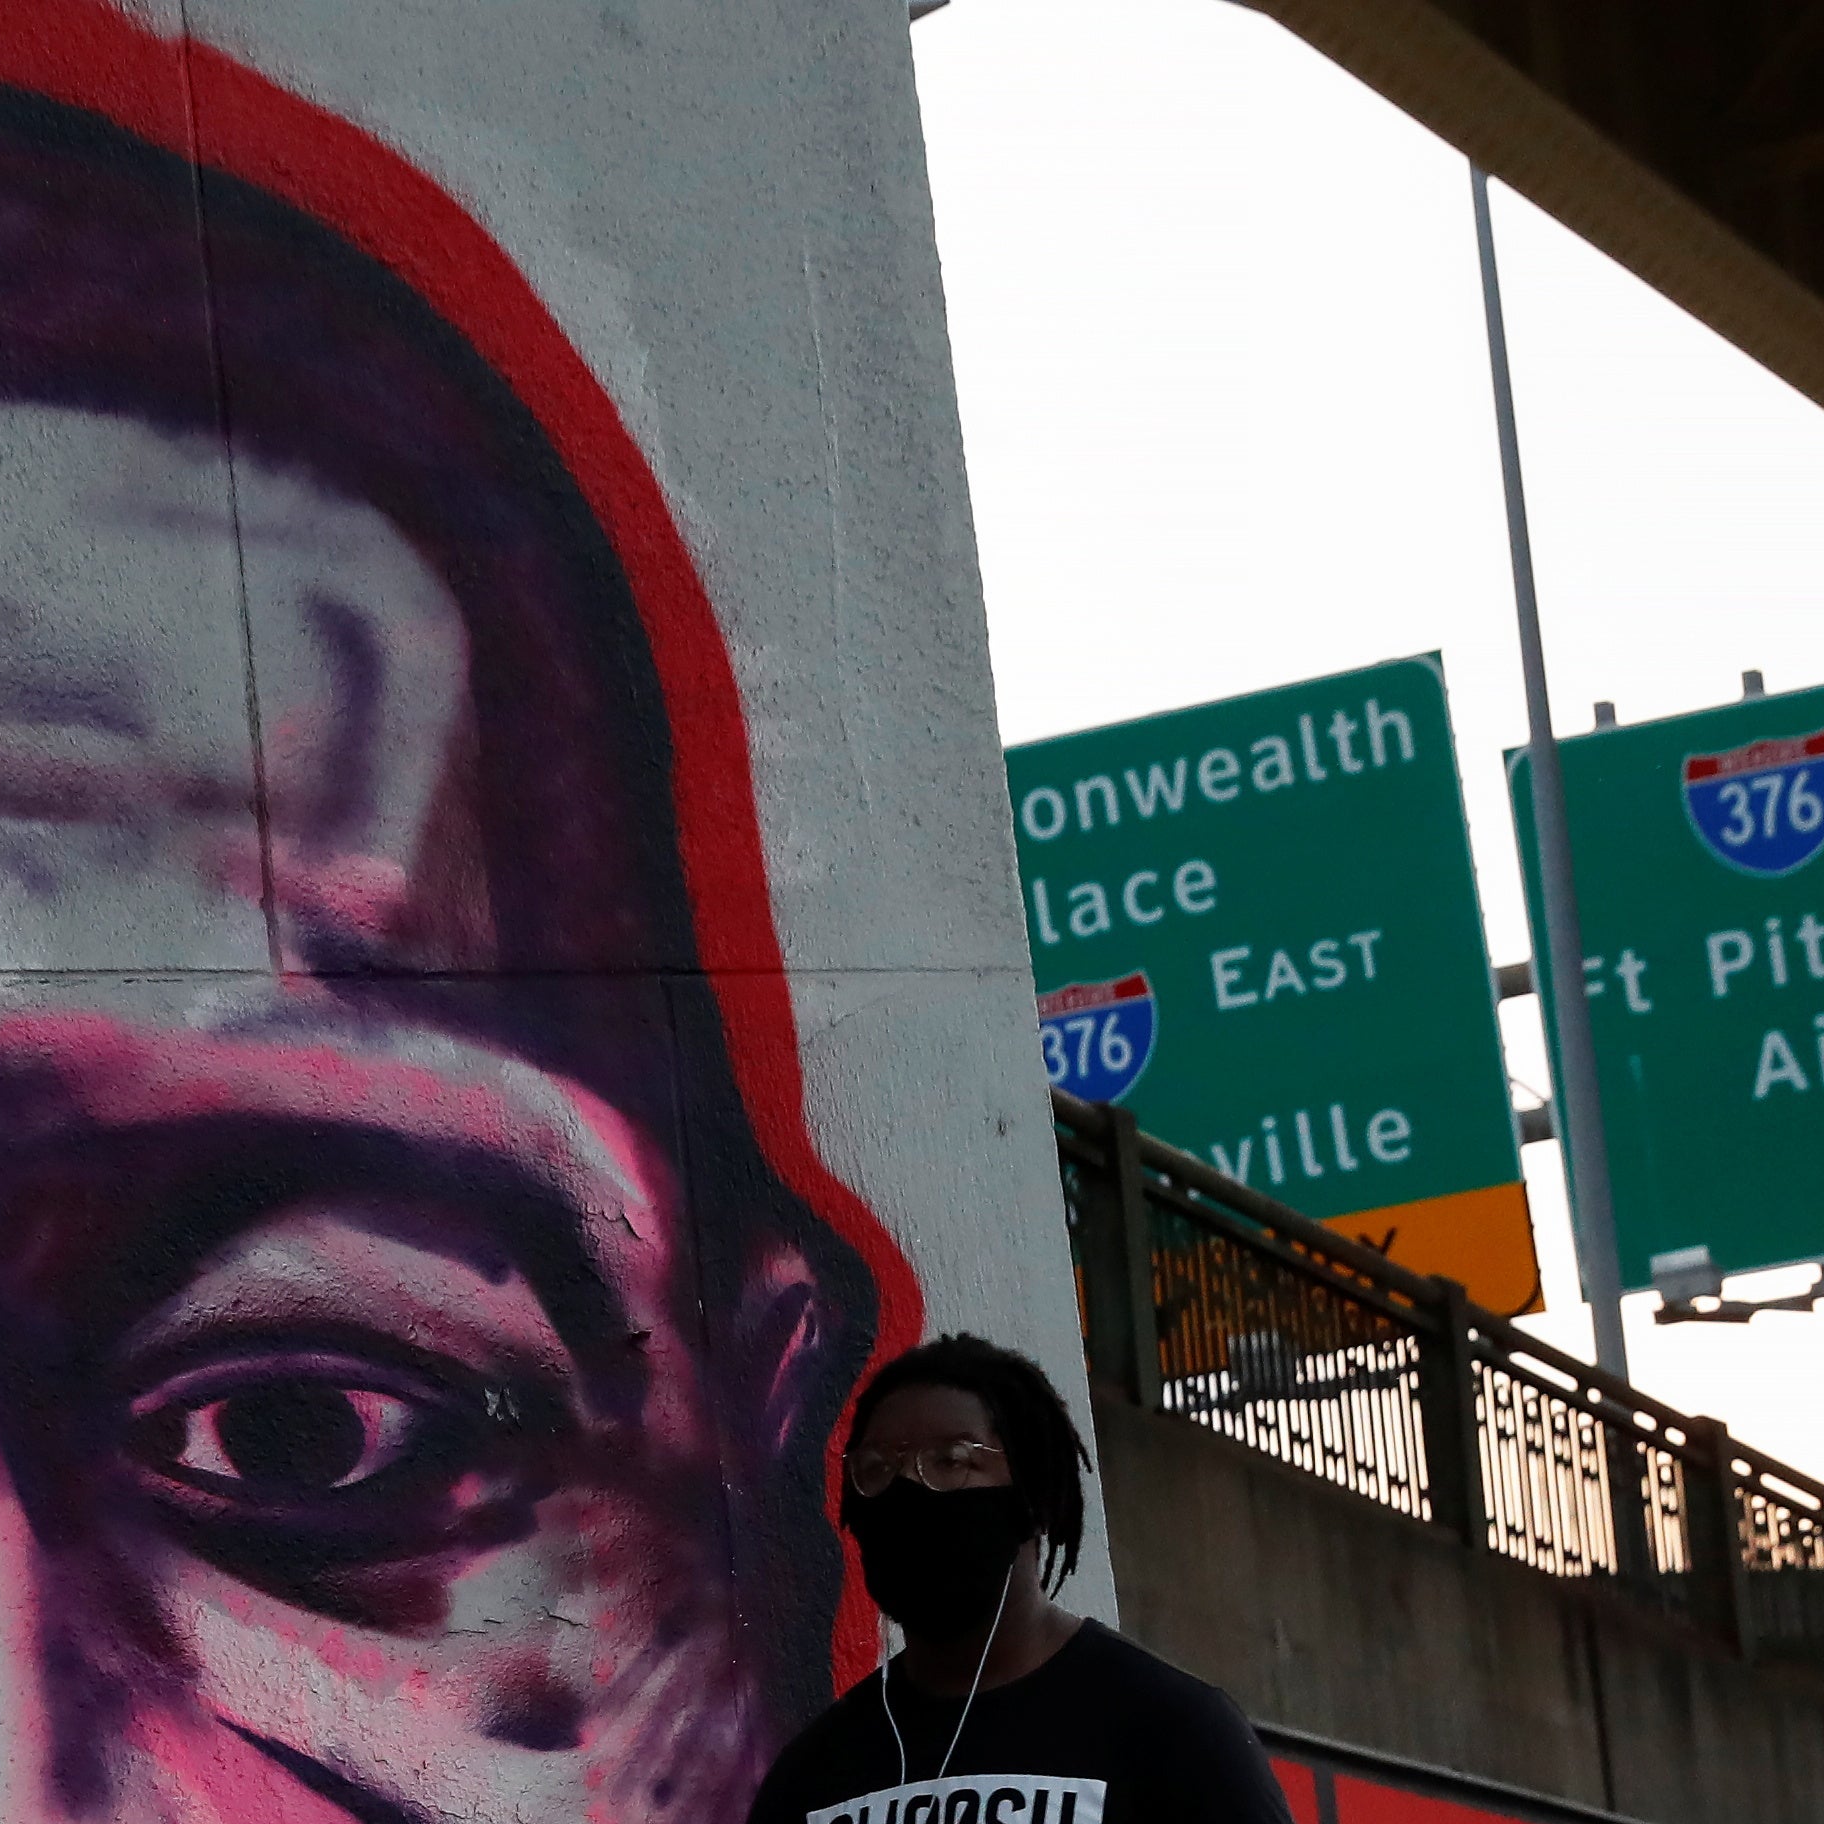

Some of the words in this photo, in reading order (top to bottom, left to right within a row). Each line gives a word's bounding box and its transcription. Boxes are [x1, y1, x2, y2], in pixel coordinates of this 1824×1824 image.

[1020, 698, 1415, 842] onwealth
[1718, 769, 1824, 846] 376
[1031, 858, 1217, 945] lace
[1210, 929, 1381, 1010] EAST
[1040, 1012, 1133, 1084] 376
